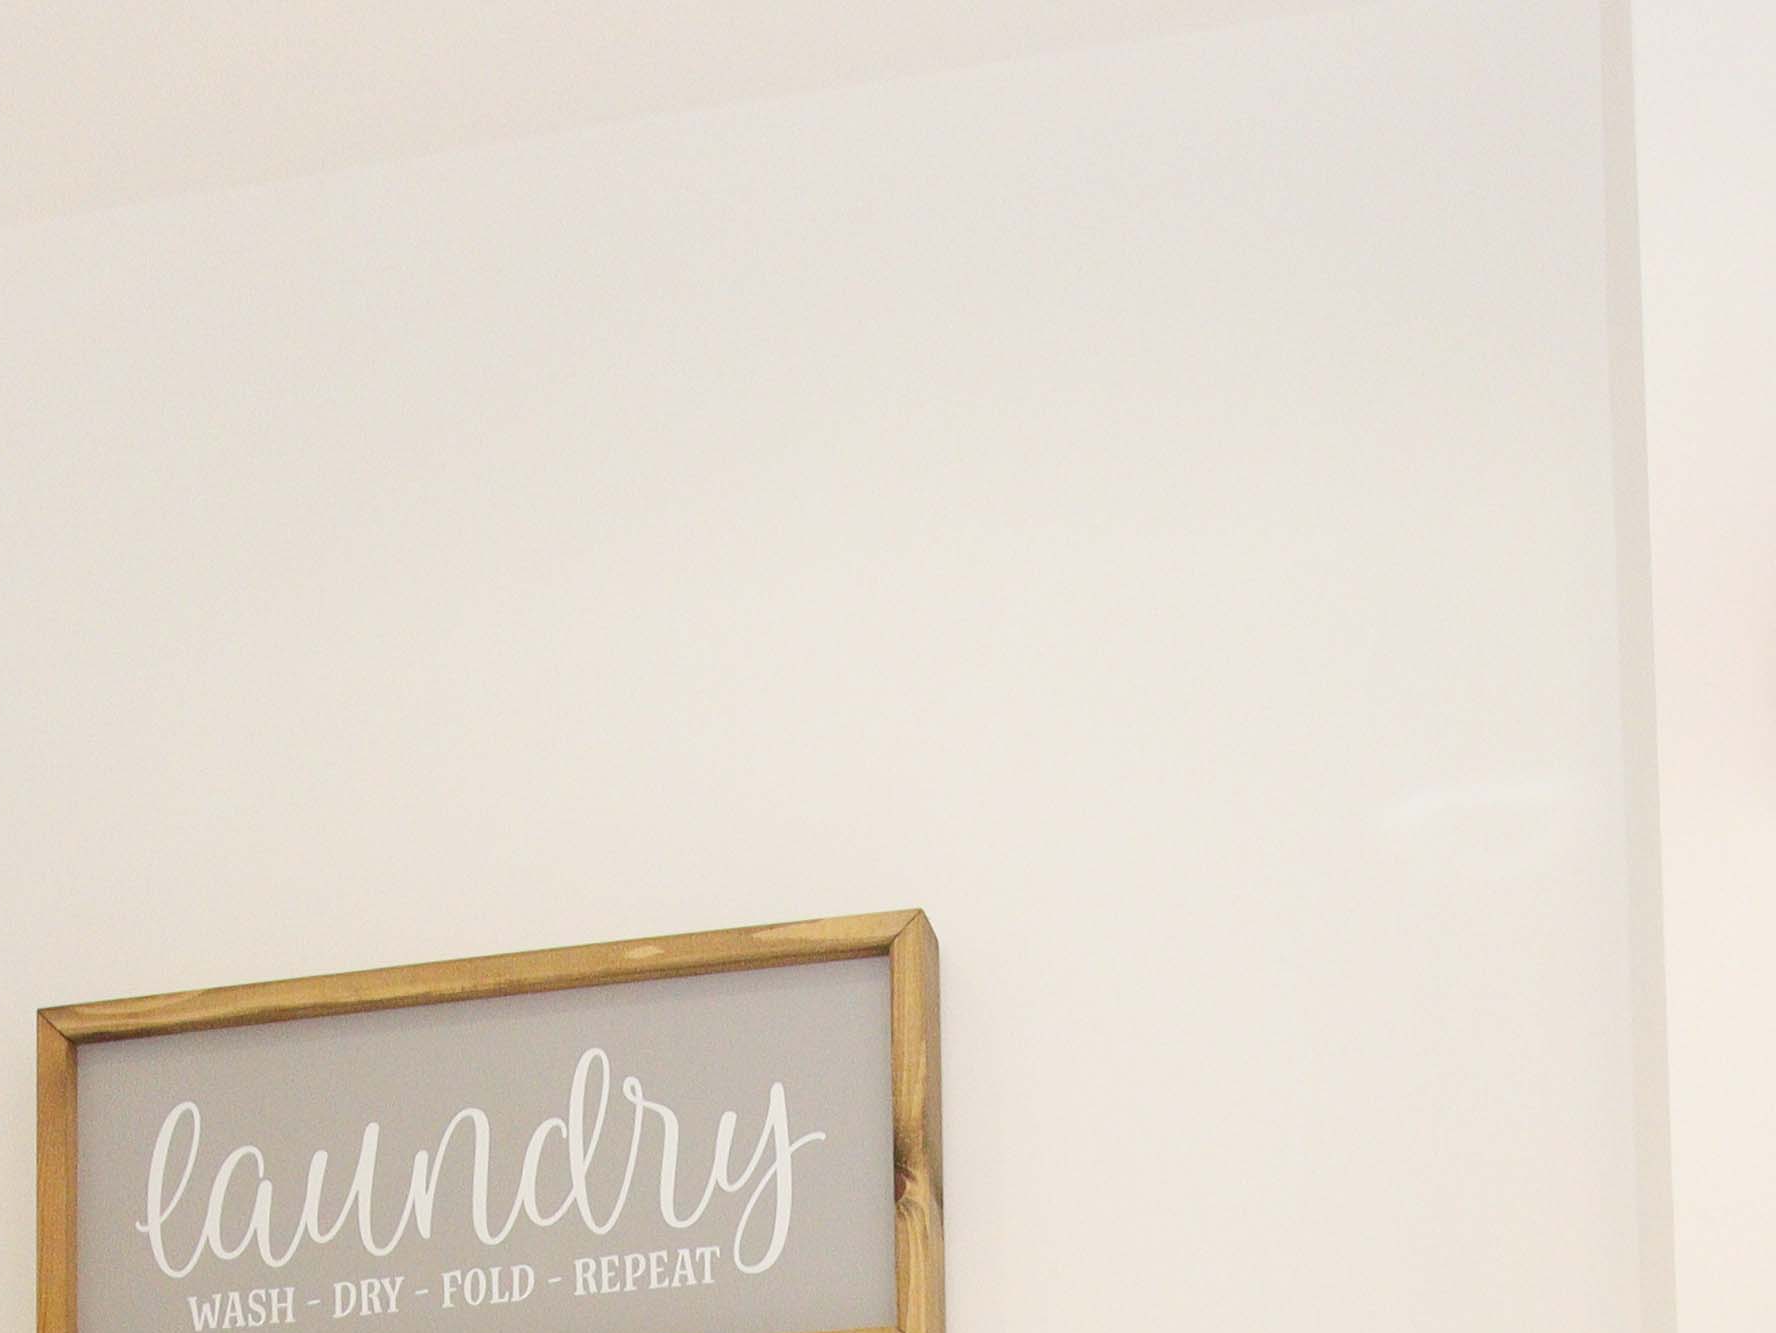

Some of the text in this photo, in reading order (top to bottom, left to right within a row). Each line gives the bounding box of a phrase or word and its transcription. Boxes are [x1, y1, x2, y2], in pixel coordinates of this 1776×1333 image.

[135, 1047, 826, 1279] laundry
[187, 1286, 296, 1332] WASH
[332, 1277, 406, 1320] DRY
[441, 1269, 534, 1309] FOLD
[573, 1246, 721, 1296] REPEAT
